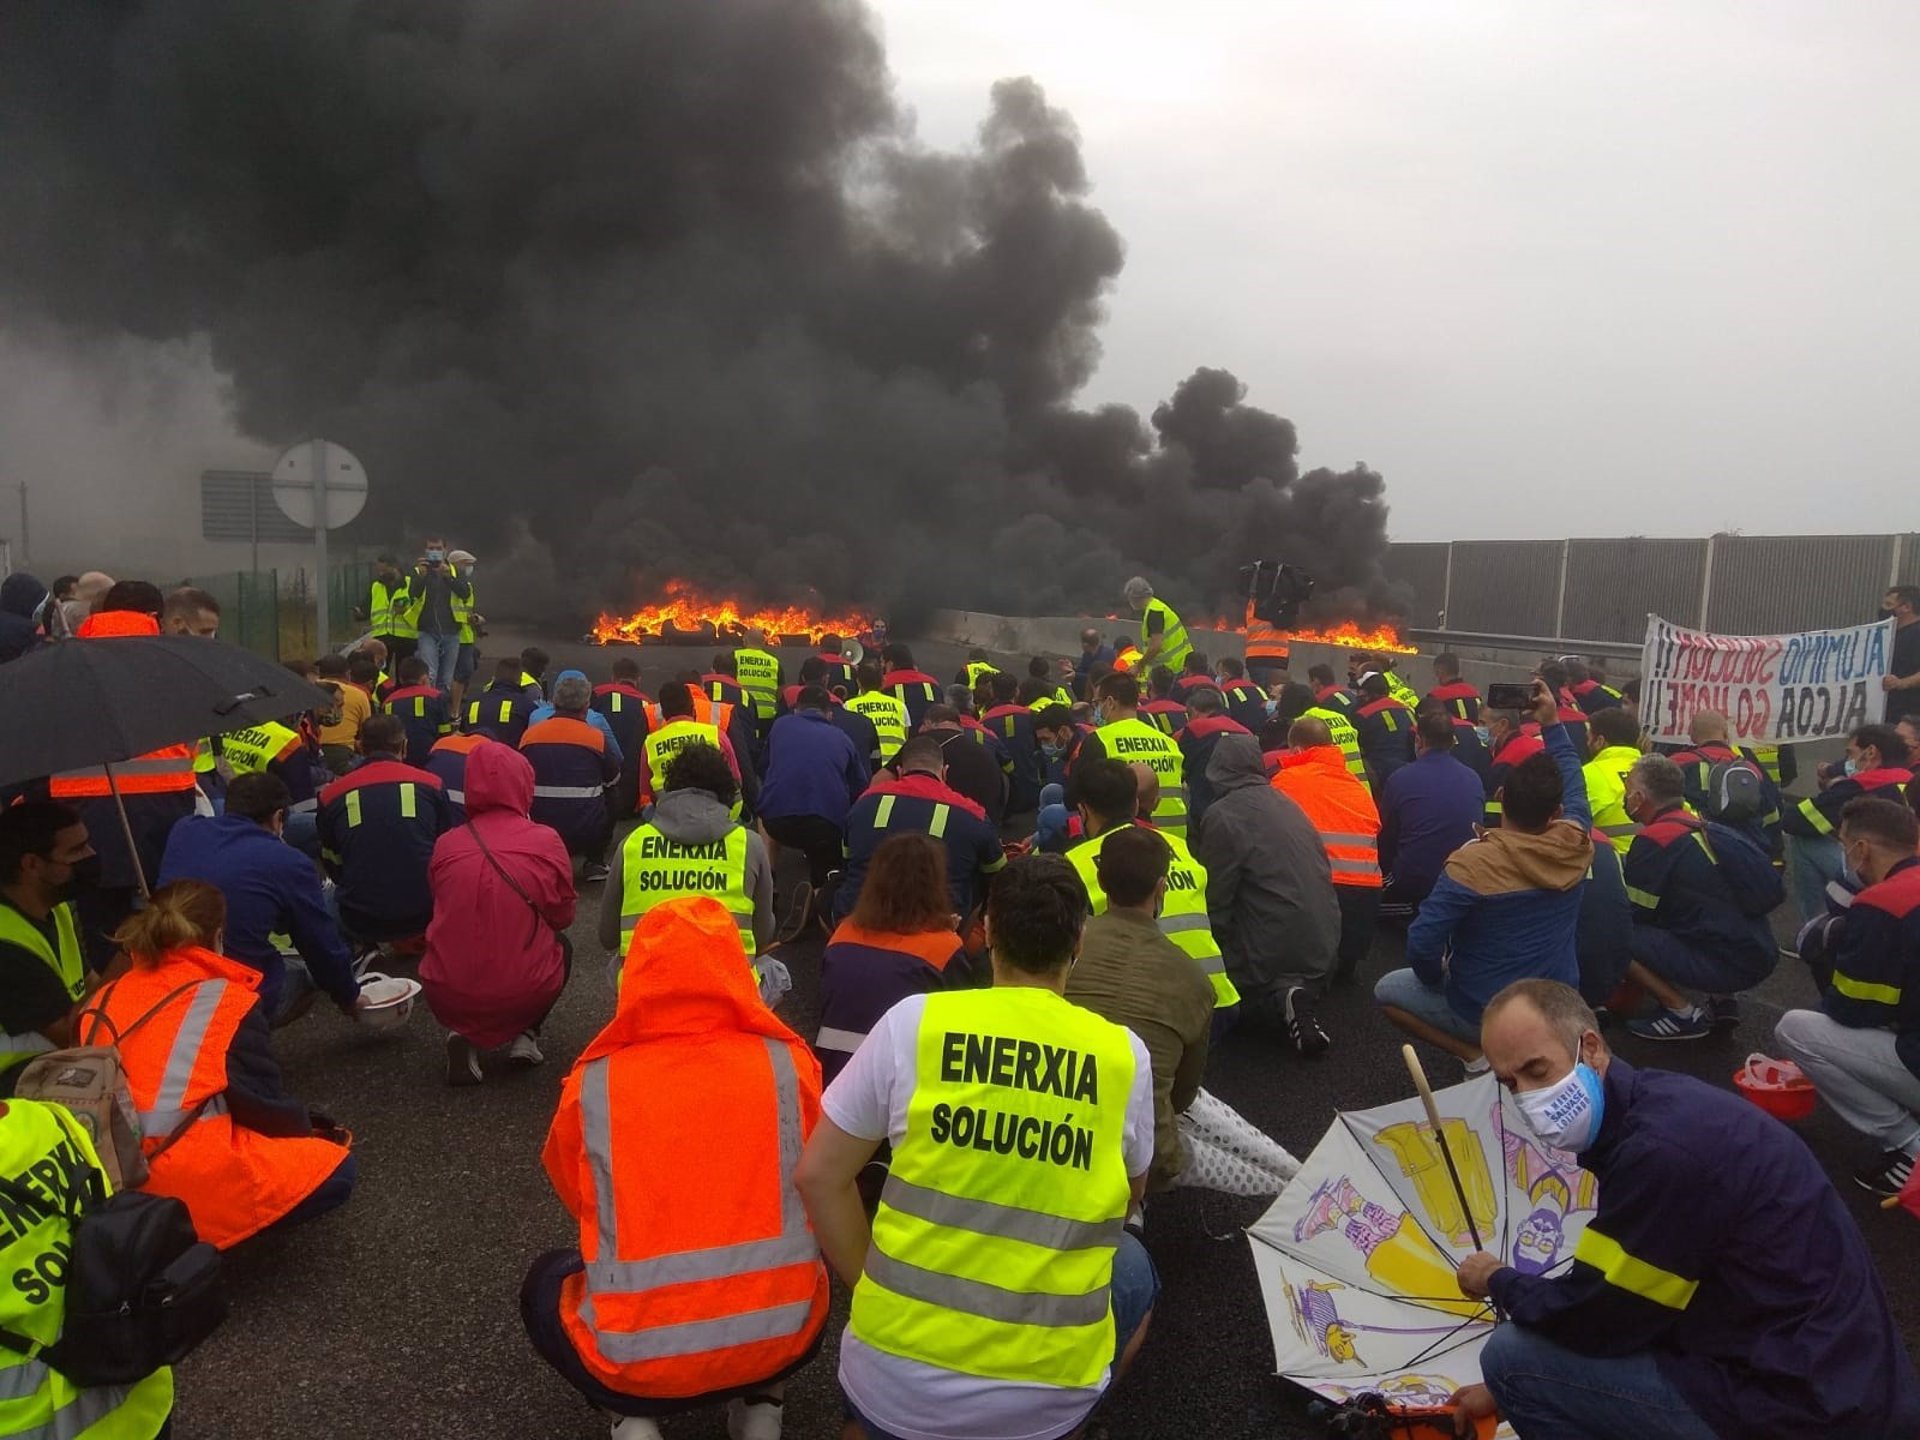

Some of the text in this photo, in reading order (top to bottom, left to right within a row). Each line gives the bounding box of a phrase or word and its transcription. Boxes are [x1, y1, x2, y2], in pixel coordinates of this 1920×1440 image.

[740, 655, 772, 667] ENERXIA
[739, 668, 772, 678] SOLUCIÓN
[856, 701, 898, 714] ENERXIA
[1115, 737, 1171, 753] ENERXIA
[640, 866, 728, 892] SOLUCIÓN
[941, 1032, 1098, 1105] ENERXIA
[1551, 1090, 1584, 1122] SALVASE
[931, 1103, 1094, 1172] SOLUCIÓN
